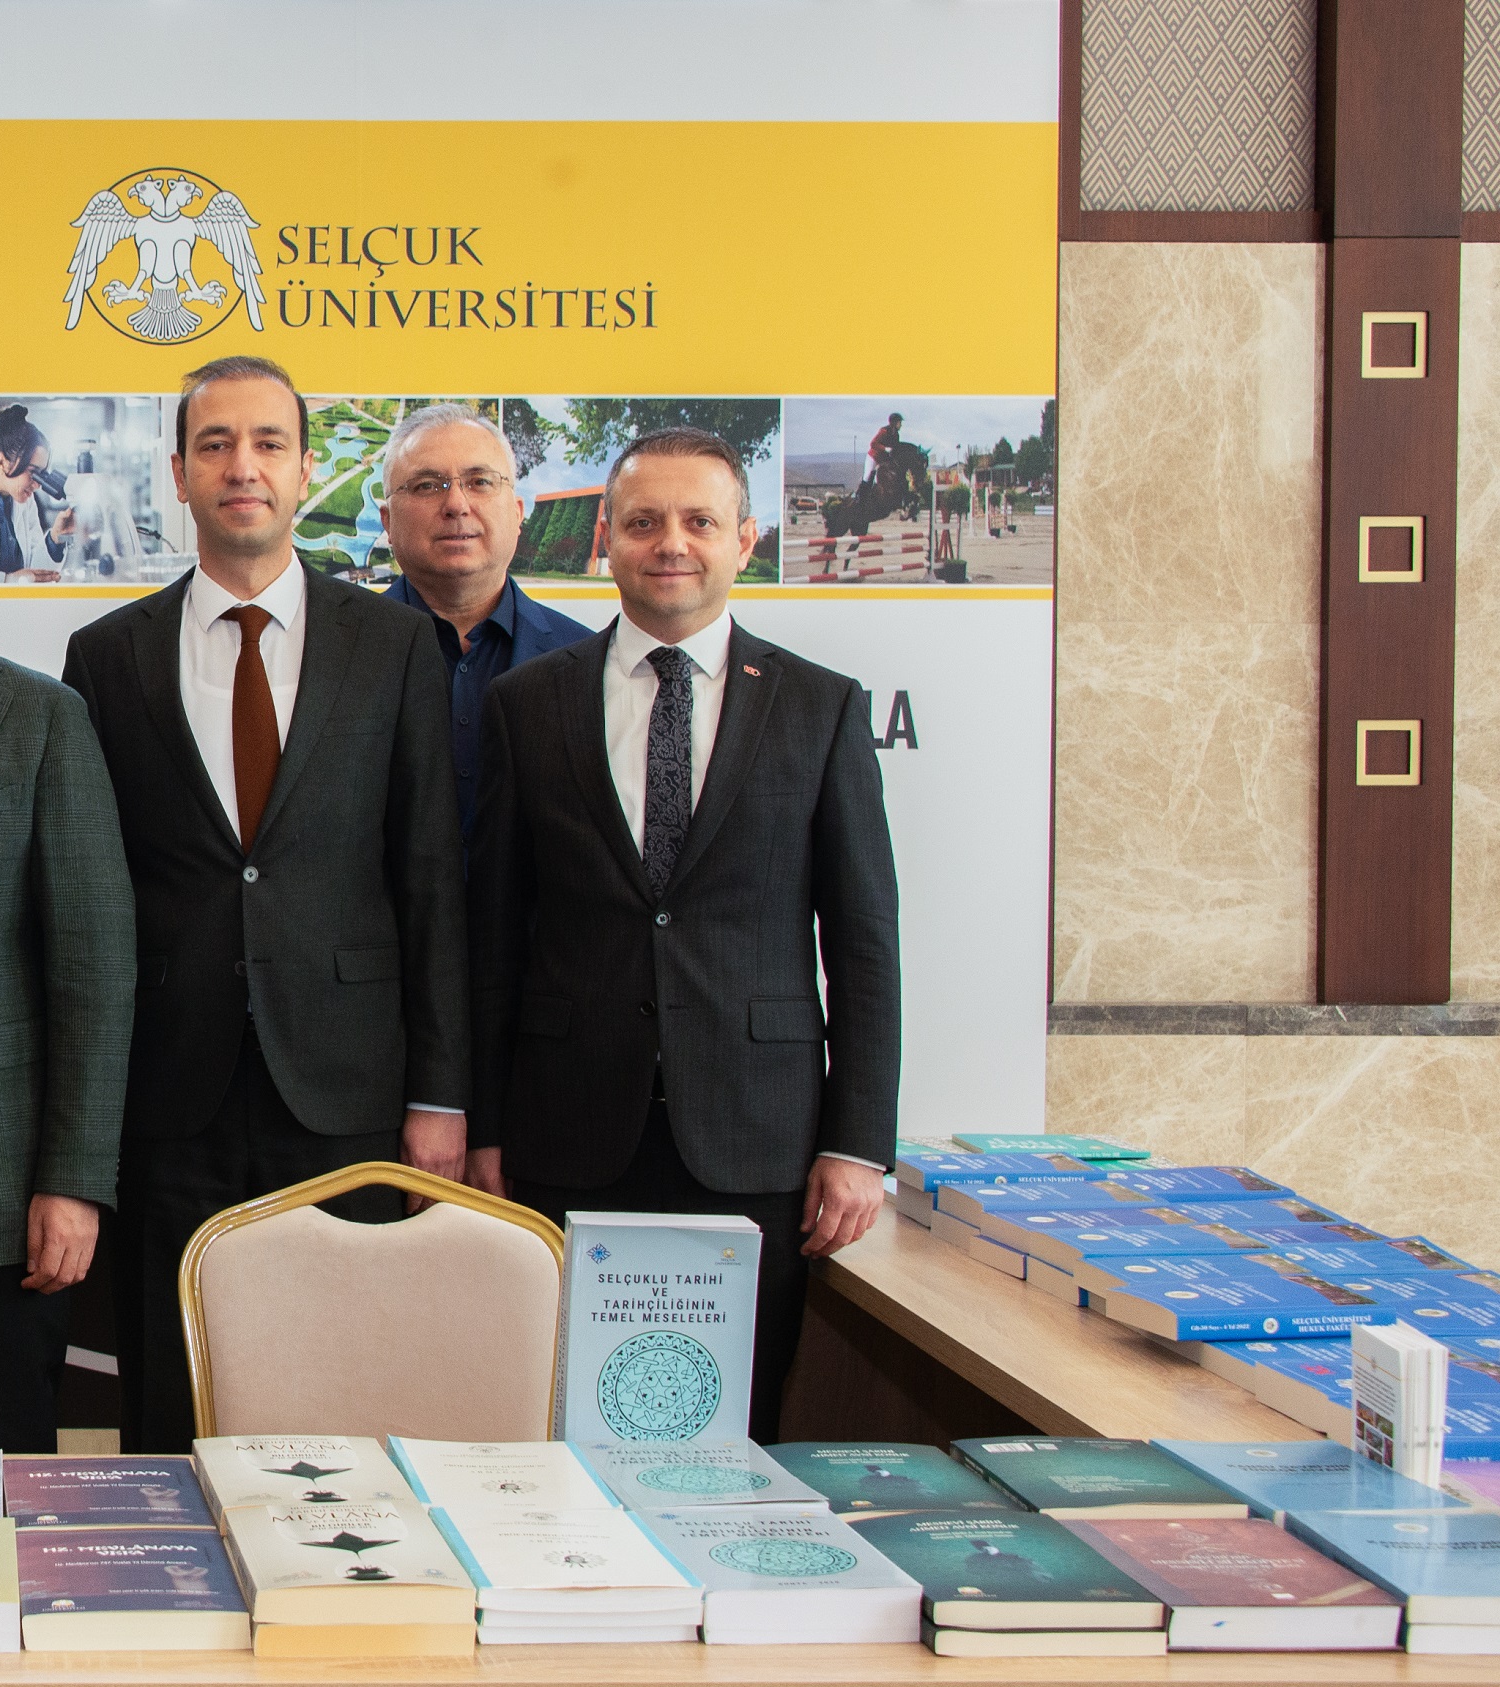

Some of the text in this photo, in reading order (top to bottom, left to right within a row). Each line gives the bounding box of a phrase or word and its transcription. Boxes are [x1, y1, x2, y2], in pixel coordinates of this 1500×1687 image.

[276, 223, 484, 278] SELÇUK
[276, 280, 658, 332] ÜNİVERSİTESİ
[598, 1273, 723, 1287] SELÇUKLU TARİHİ
[652, 1287, 668, 1297] VE
[603, 1298, 715, 1312] TARİHÇİLİĞİNİN
[591, 1311, 726, 1323] TEMEL MESELELERİ
